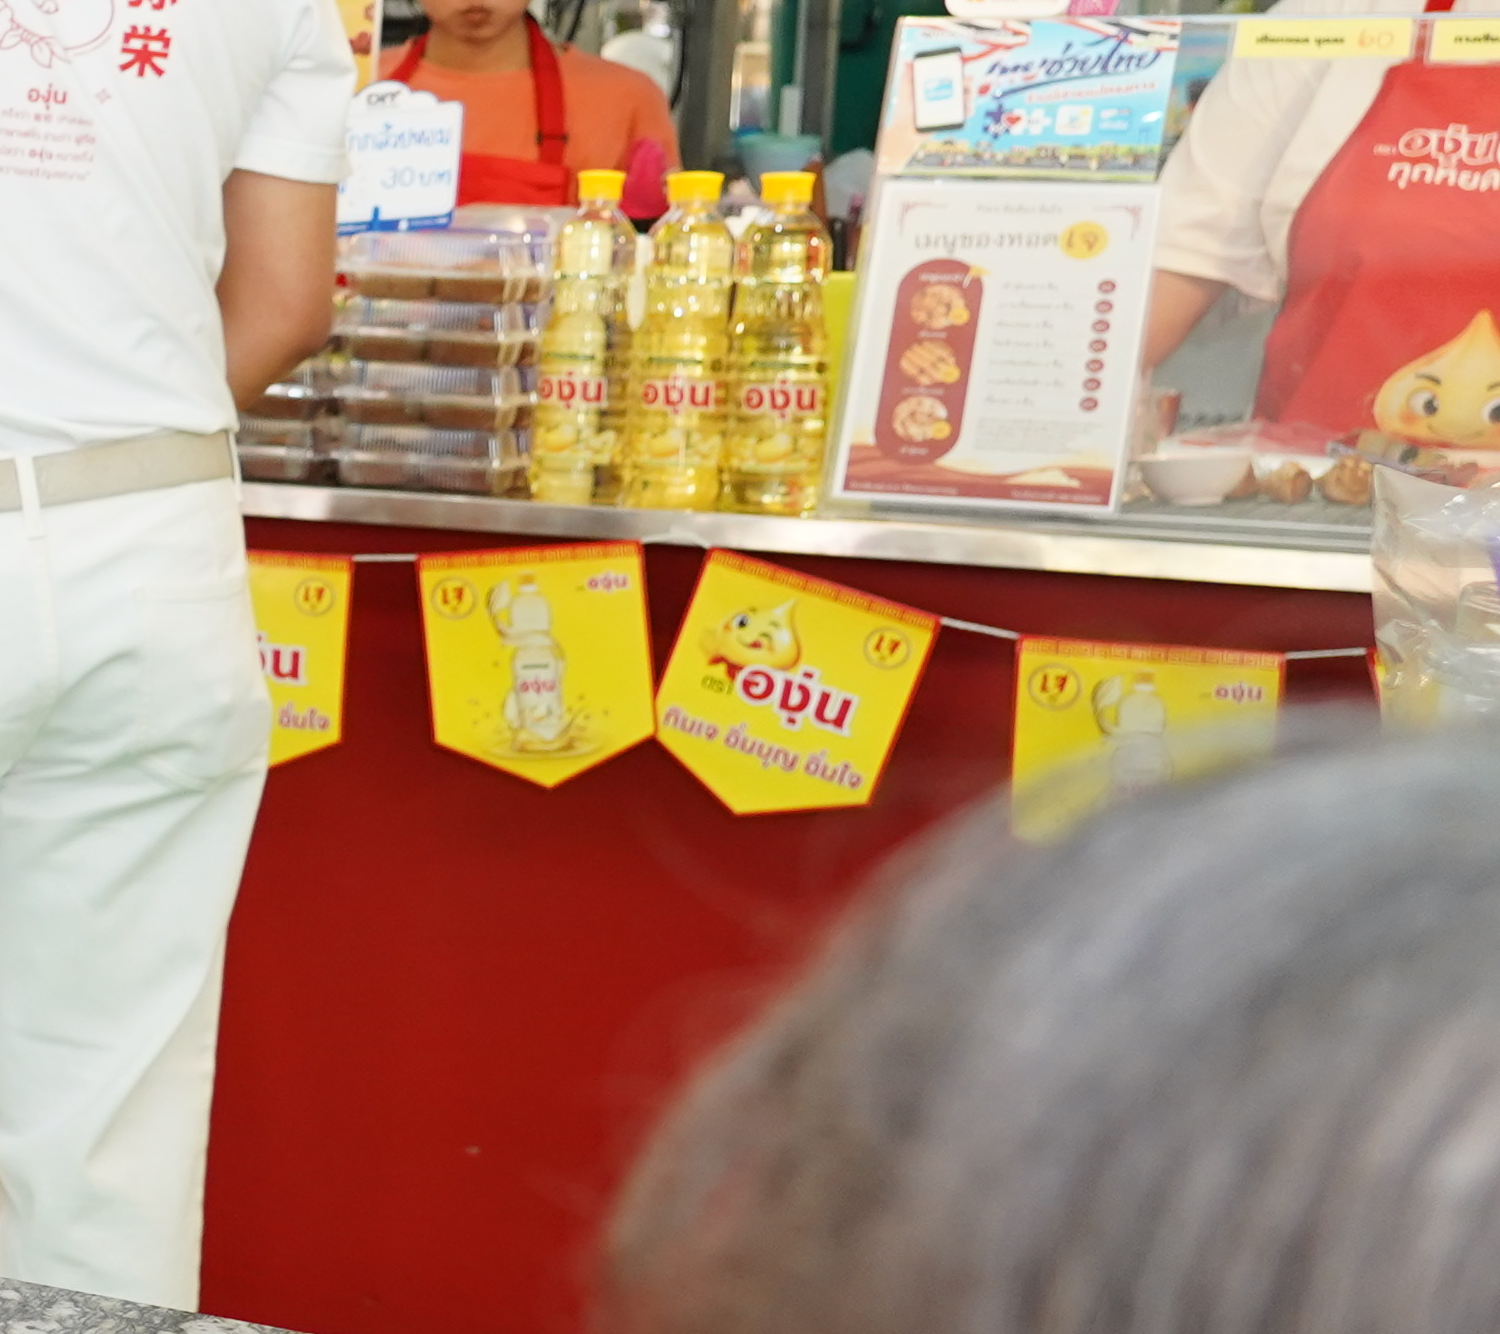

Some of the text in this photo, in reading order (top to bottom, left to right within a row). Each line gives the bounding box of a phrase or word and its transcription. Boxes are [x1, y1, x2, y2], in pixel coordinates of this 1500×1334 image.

[26, 83, 68, 112] องุ่น
[538, 370, 606, 410] องุ่น
[641, 374, 712, 415] องุ่น
[744, 377, 819, 420] องุ่น
[741, 671, 853, 732] องุ่น
